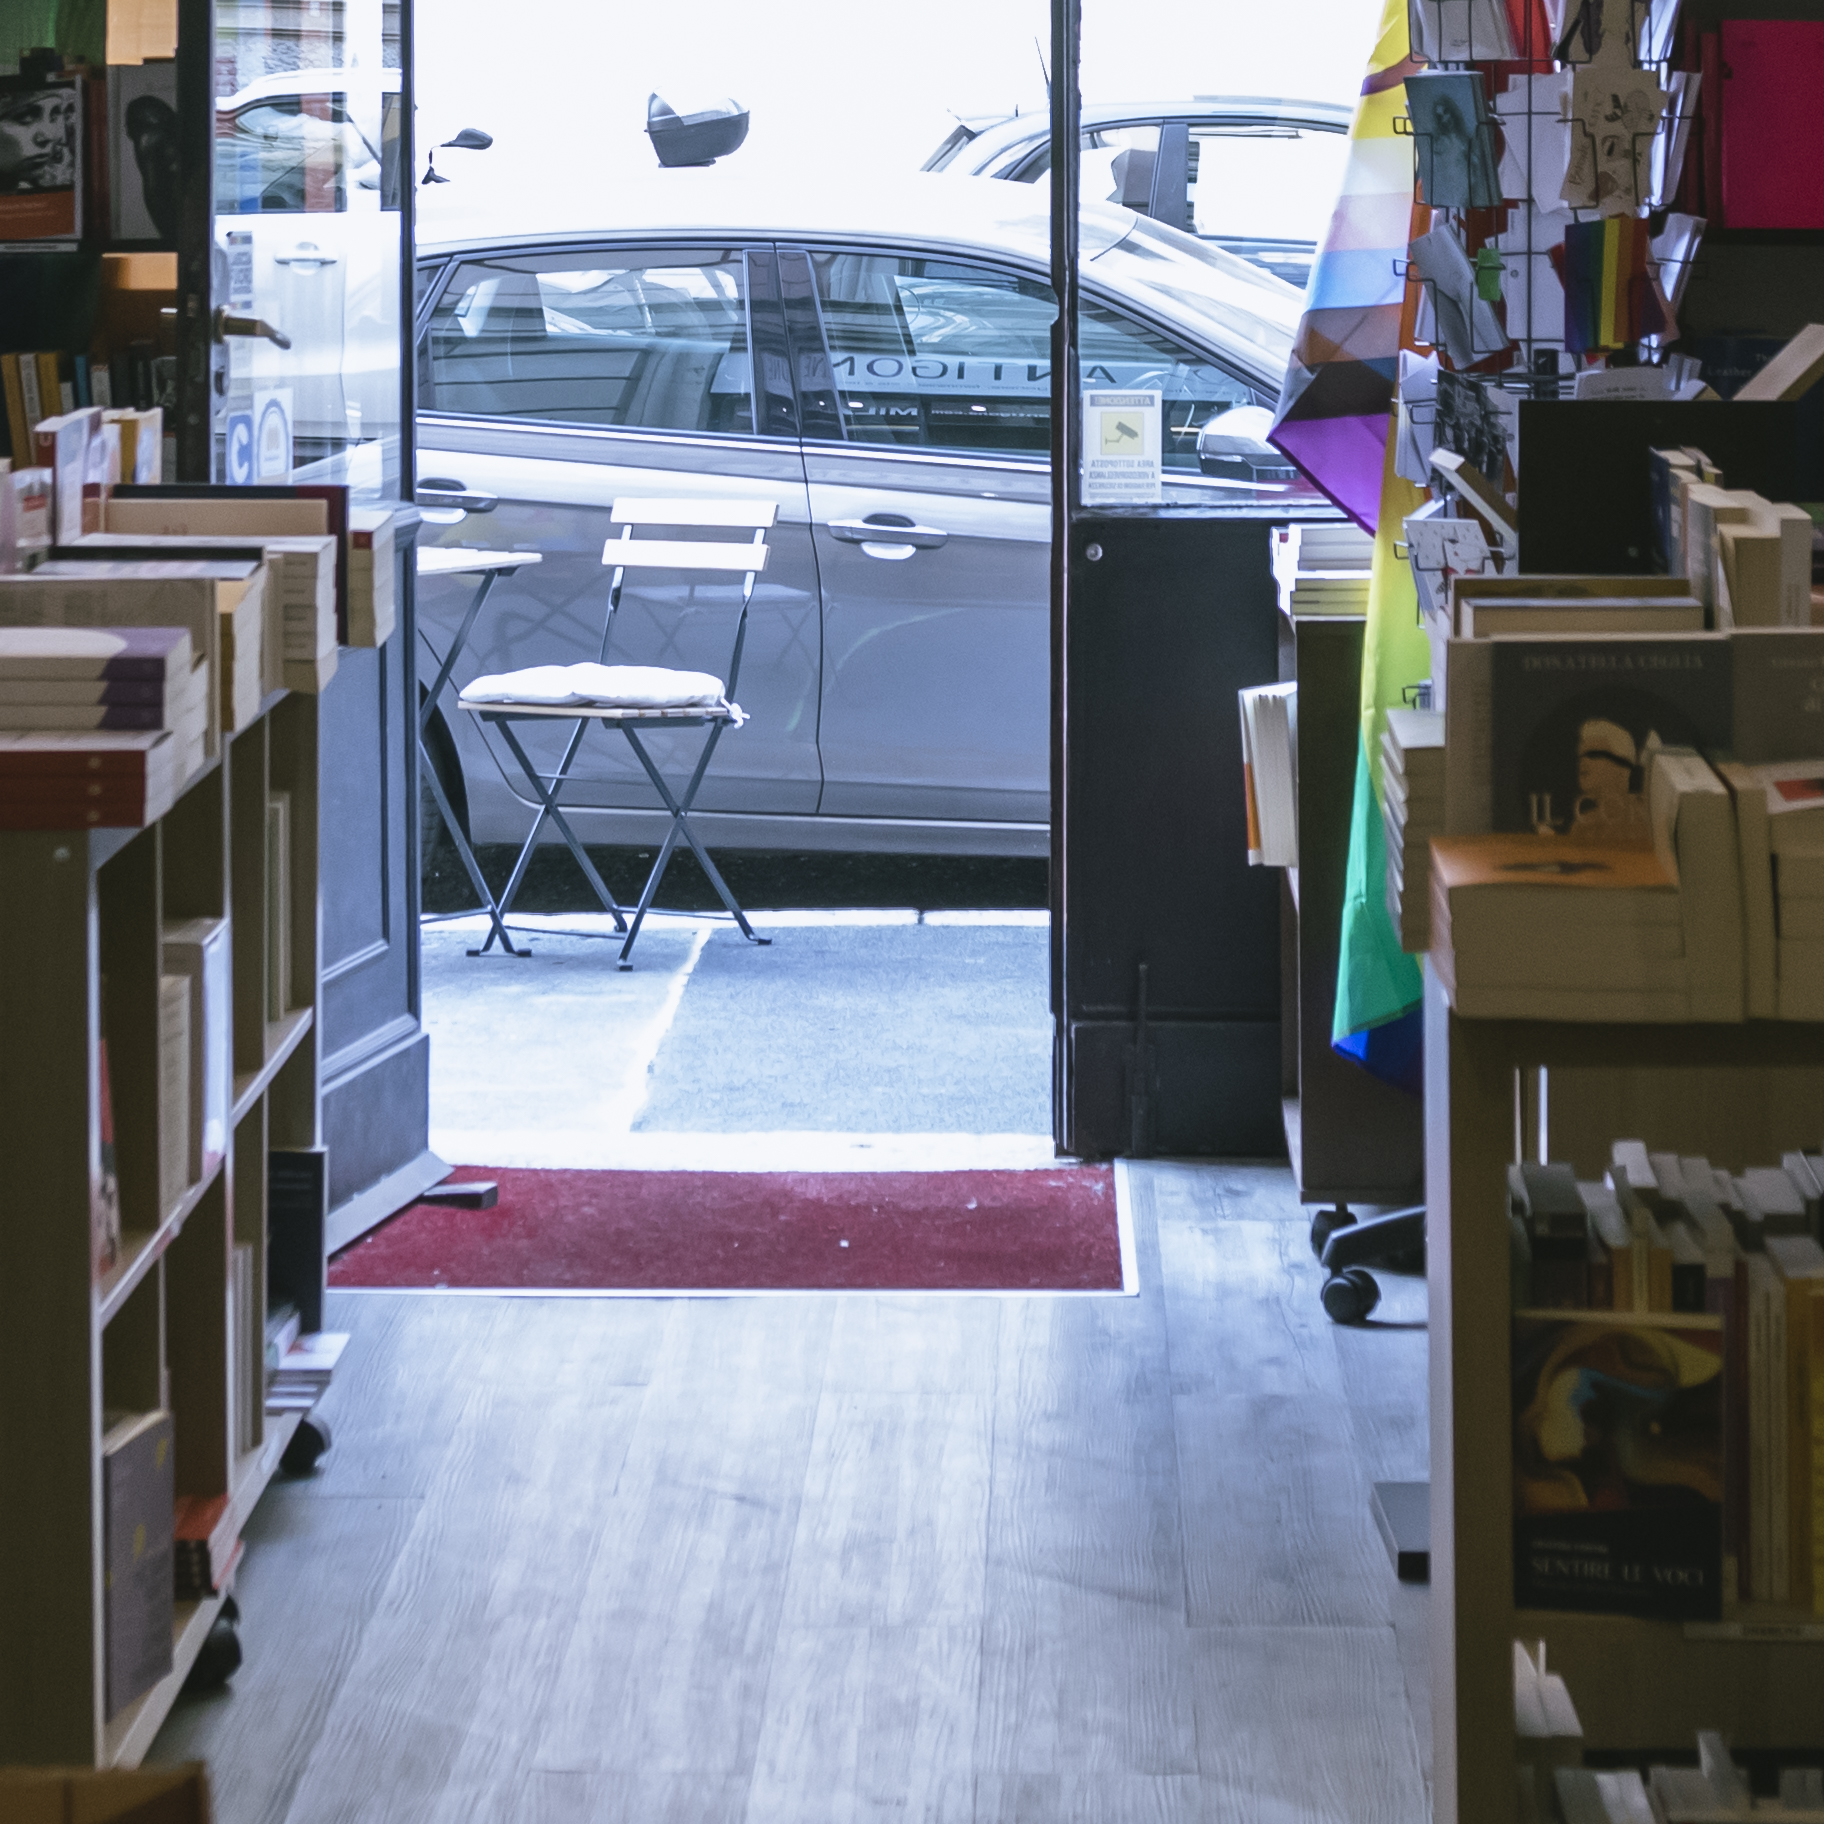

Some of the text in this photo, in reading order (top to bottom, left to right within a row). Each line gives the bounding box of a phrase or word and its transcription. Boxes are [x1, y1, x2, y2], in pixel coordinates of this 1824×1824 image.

[1530, 1556, 1613, 1581] SENTIRE
[1622, 1563, 1645, 1583] LE
[1653, 1565, 1705, 1587] VOCI
